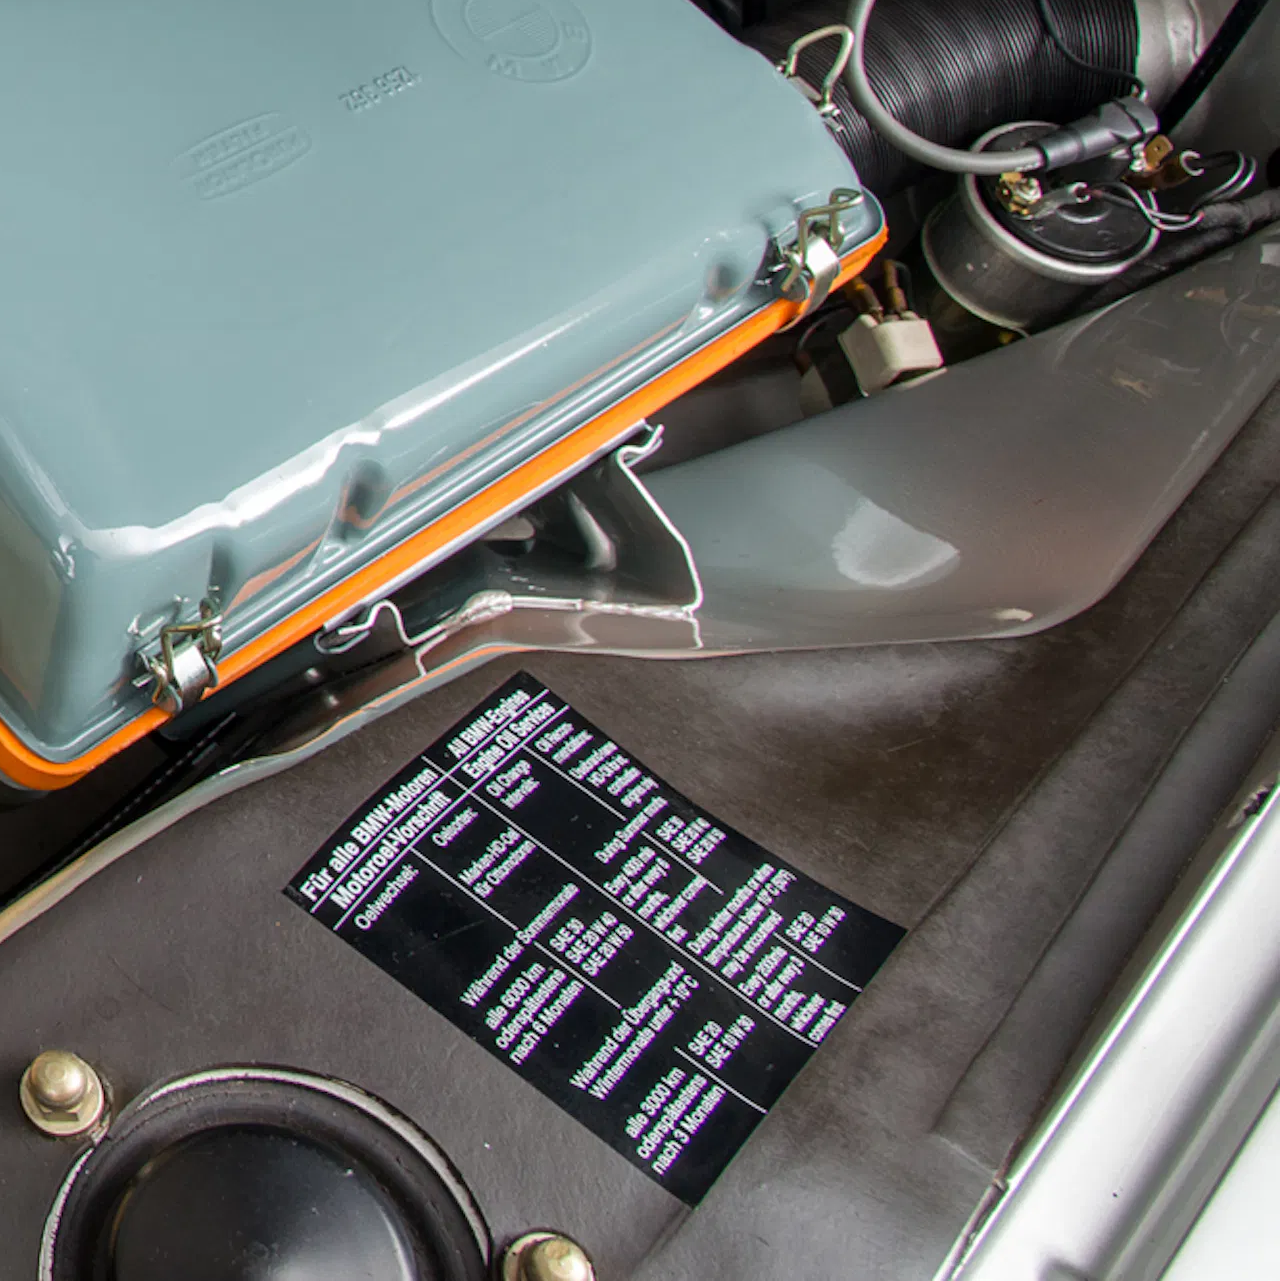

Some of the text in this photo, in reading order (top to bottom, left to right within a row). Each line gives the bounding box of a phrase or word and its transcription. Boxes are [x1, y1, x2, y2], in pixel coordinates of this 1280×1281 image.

[446, 689, 531, 760] All BMW-Engines
[460, 701, 556, 780] Engine Oil Services
[299, 767, 439, 902] Für alle BMW-Motoren
[329, 790, 452, 910] Motoroel-Vorschrift
[354, 864, 419, 930] Oelwechsel:
[503, 939, 524, 962] der
[549, 917, 585, 953] SAE 30
[564, 938, 592, 964] SAE
[581, 929, 601, 947] 20
[581, 951, 608, 977] SAE
[597, 941, 617, 960] 20
[485, 962, 546, 1031] alle 6000 km
[509, 979, 585, 1065] nach 6 Monaten
[611, 1020, 634, 1043] der
[687, 1020, 723, 1056] SAE 20
[704, 1042, 732, 1070] SAE
[625, 1066, 686, 1139] alle 3000 km
[651, 1084, 727, 1175] nach 3 Monaten
